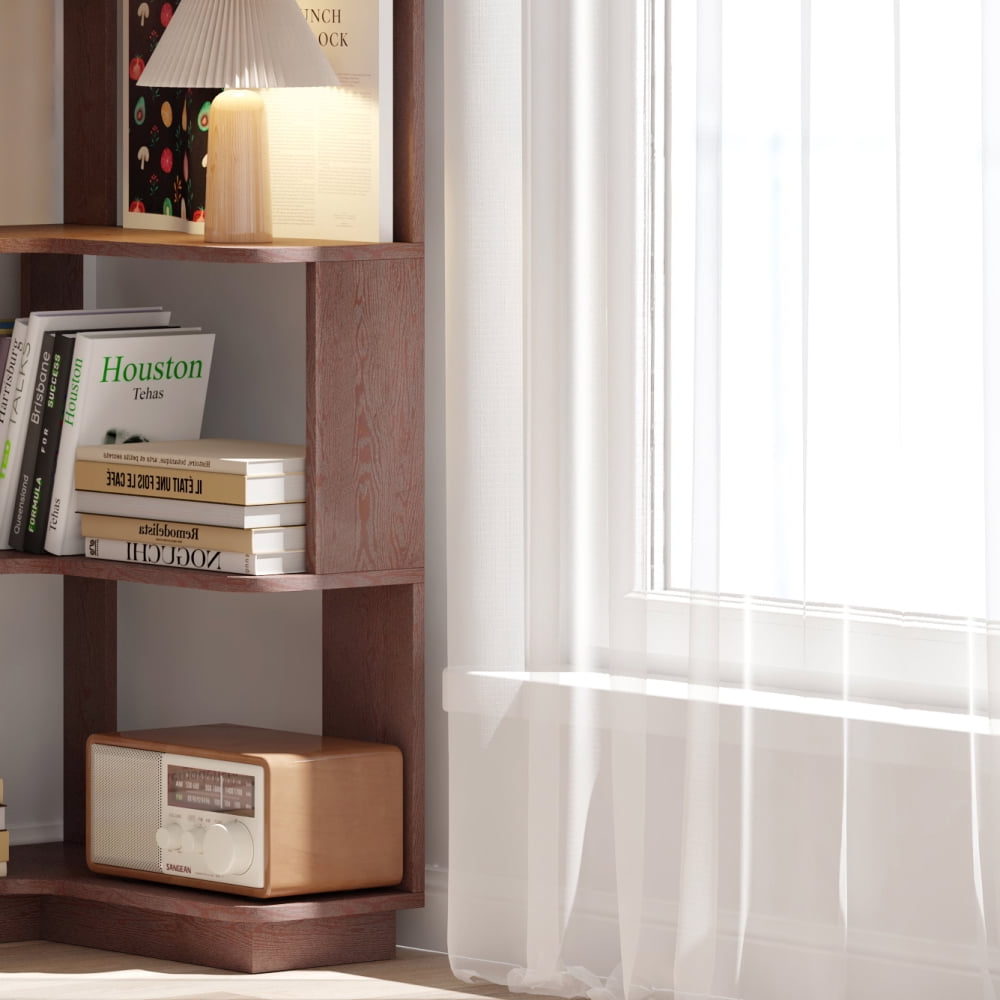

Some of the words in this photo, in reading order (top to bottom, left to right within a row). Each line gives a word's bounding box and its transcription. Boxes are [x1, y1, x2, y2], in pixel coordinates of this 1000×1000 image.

[64, 358, 83, 426] Houston
[100, 356, 203, 383] Houston
[133, 387, 164, 400] Tehas
[13, 474, 29, 534] Queensland
[30, 351, 50, 425] Brisbane
[28, 477, 42, 533] FORMULA
[47, 353, 61, 408] SUCCESS
